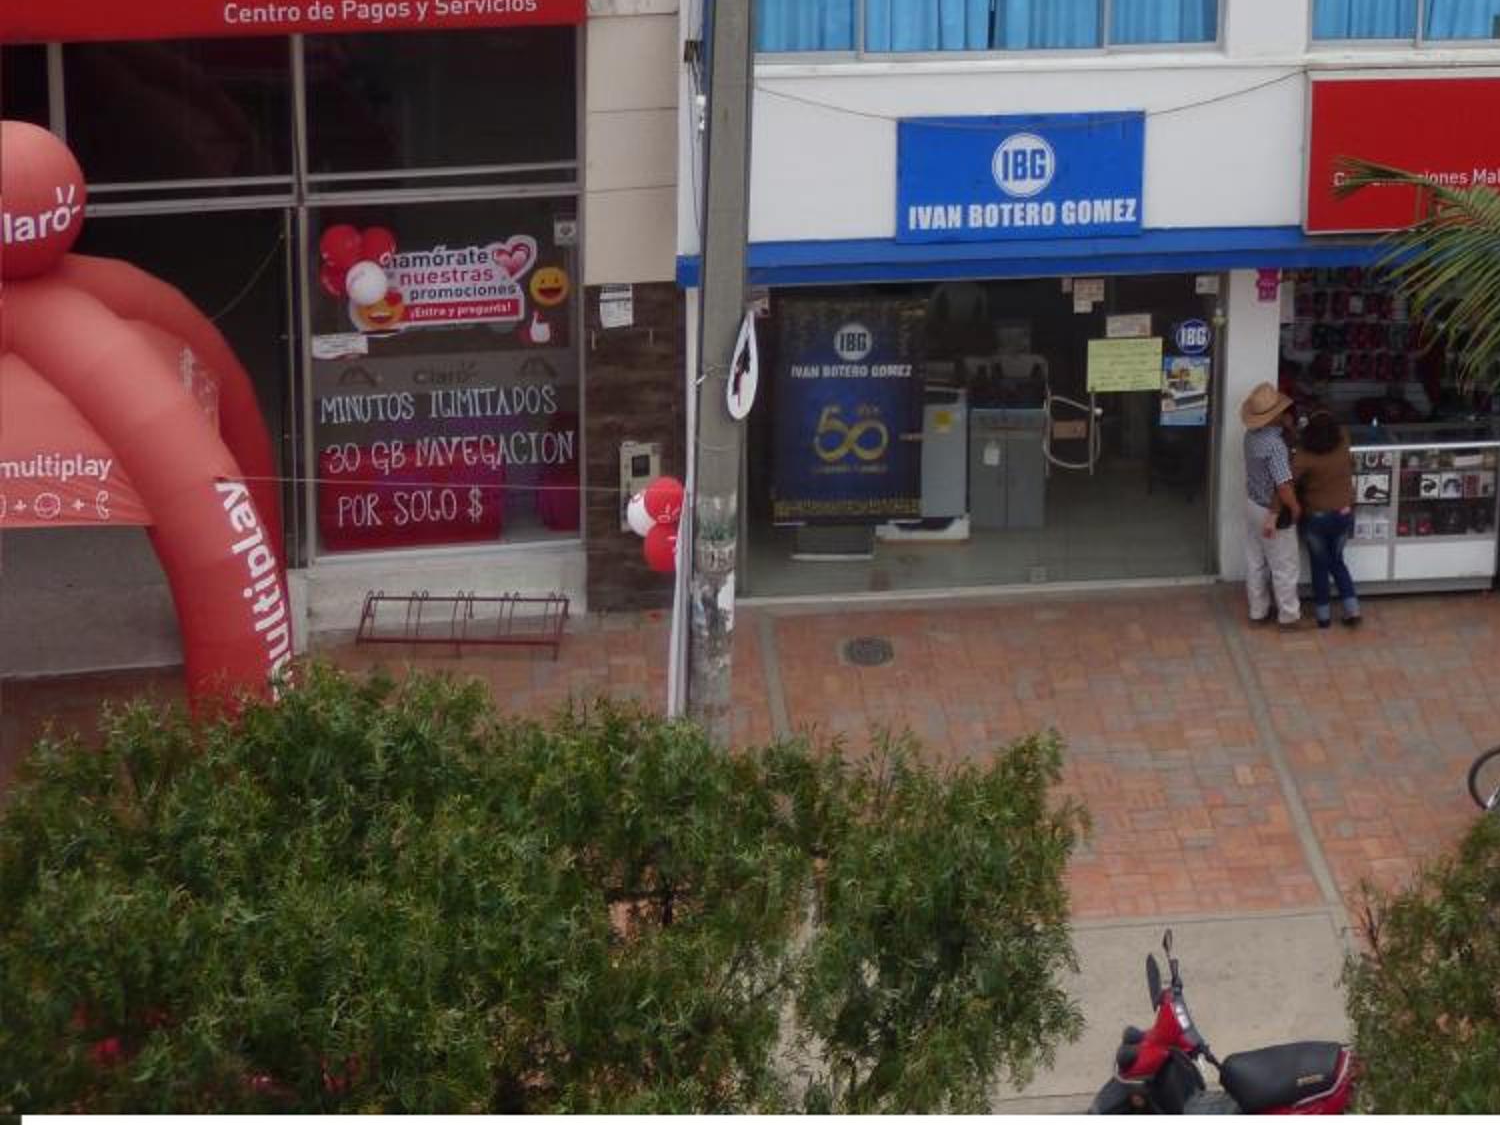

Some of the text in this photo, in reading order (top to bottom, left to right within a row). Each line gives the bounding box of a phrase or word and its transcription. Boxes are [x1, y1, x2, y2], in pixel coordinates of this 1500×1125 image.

[223, 2, 301, 25] Centro
[308, 0, 335, 20] de
[341, 0, 410, 24] Pagos
[416, 0, 428, 21] y
[1002, 148, 1048, 182] IBG
[908, 198, 1138, 230] IVAN BOTERO GOMEZ
[400, 267, 494, 285] nuestras
[409, 284, 517, 302] promociones
[839, 333, 868, 352] IBG
[1181, 326, 1208, 346] IBG
[791, 364, 913, 379] IVAN BOTERO GOMEZ
[320, 391, 416, 424] MINUTOS
[325, 430, 576, 476] 30 GB NAVEGACION
[337, 484, 483, 528] POR SOLO $
